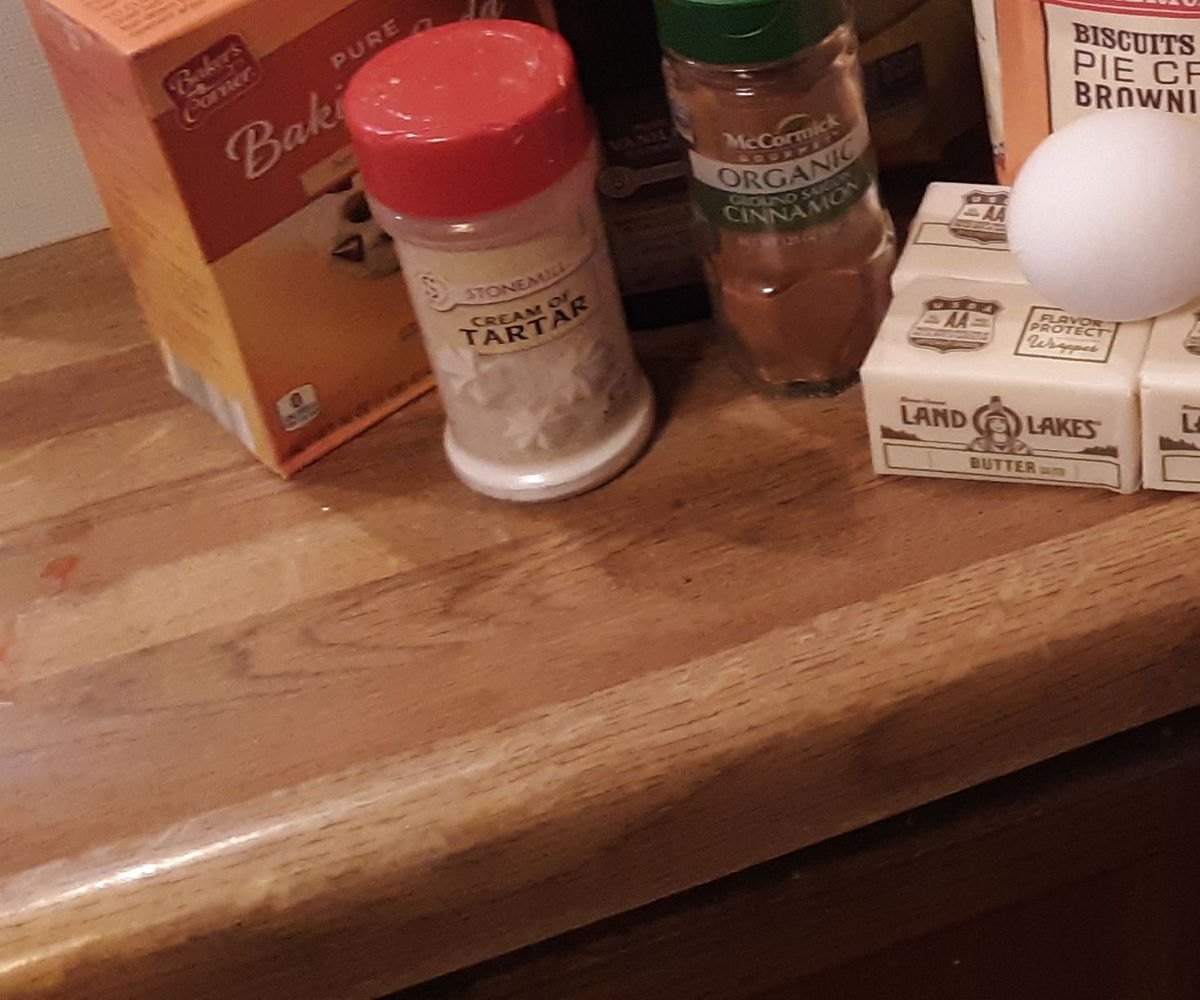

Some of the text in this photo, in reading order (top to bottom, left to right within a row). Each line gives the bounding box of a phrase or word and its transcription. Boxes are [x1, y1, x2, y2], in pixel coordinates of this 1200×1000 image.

[329, 17, 401, 71] PURE
[1072, 22, 1196, 57] BISCUITS
[1074, 50, 1136, 84] PIE
[225, 82, 345, 181] Baki
[717, 137, 854, 190] ORGANIC
[722, 180, 860, 225] CINNAMON
[458, 294, 589, 347] TARTAR
[470, 289, 571, 328] CREAM OF
[942, 310, 971, 330] AA
[1039, 313, 1103, 328] FLAVOR
[1029, 321, 1108, 339] PROTECT
[900, 404, 1097, 440] LAND LAKES
[969, 456, 1037, 475] BUTTER
